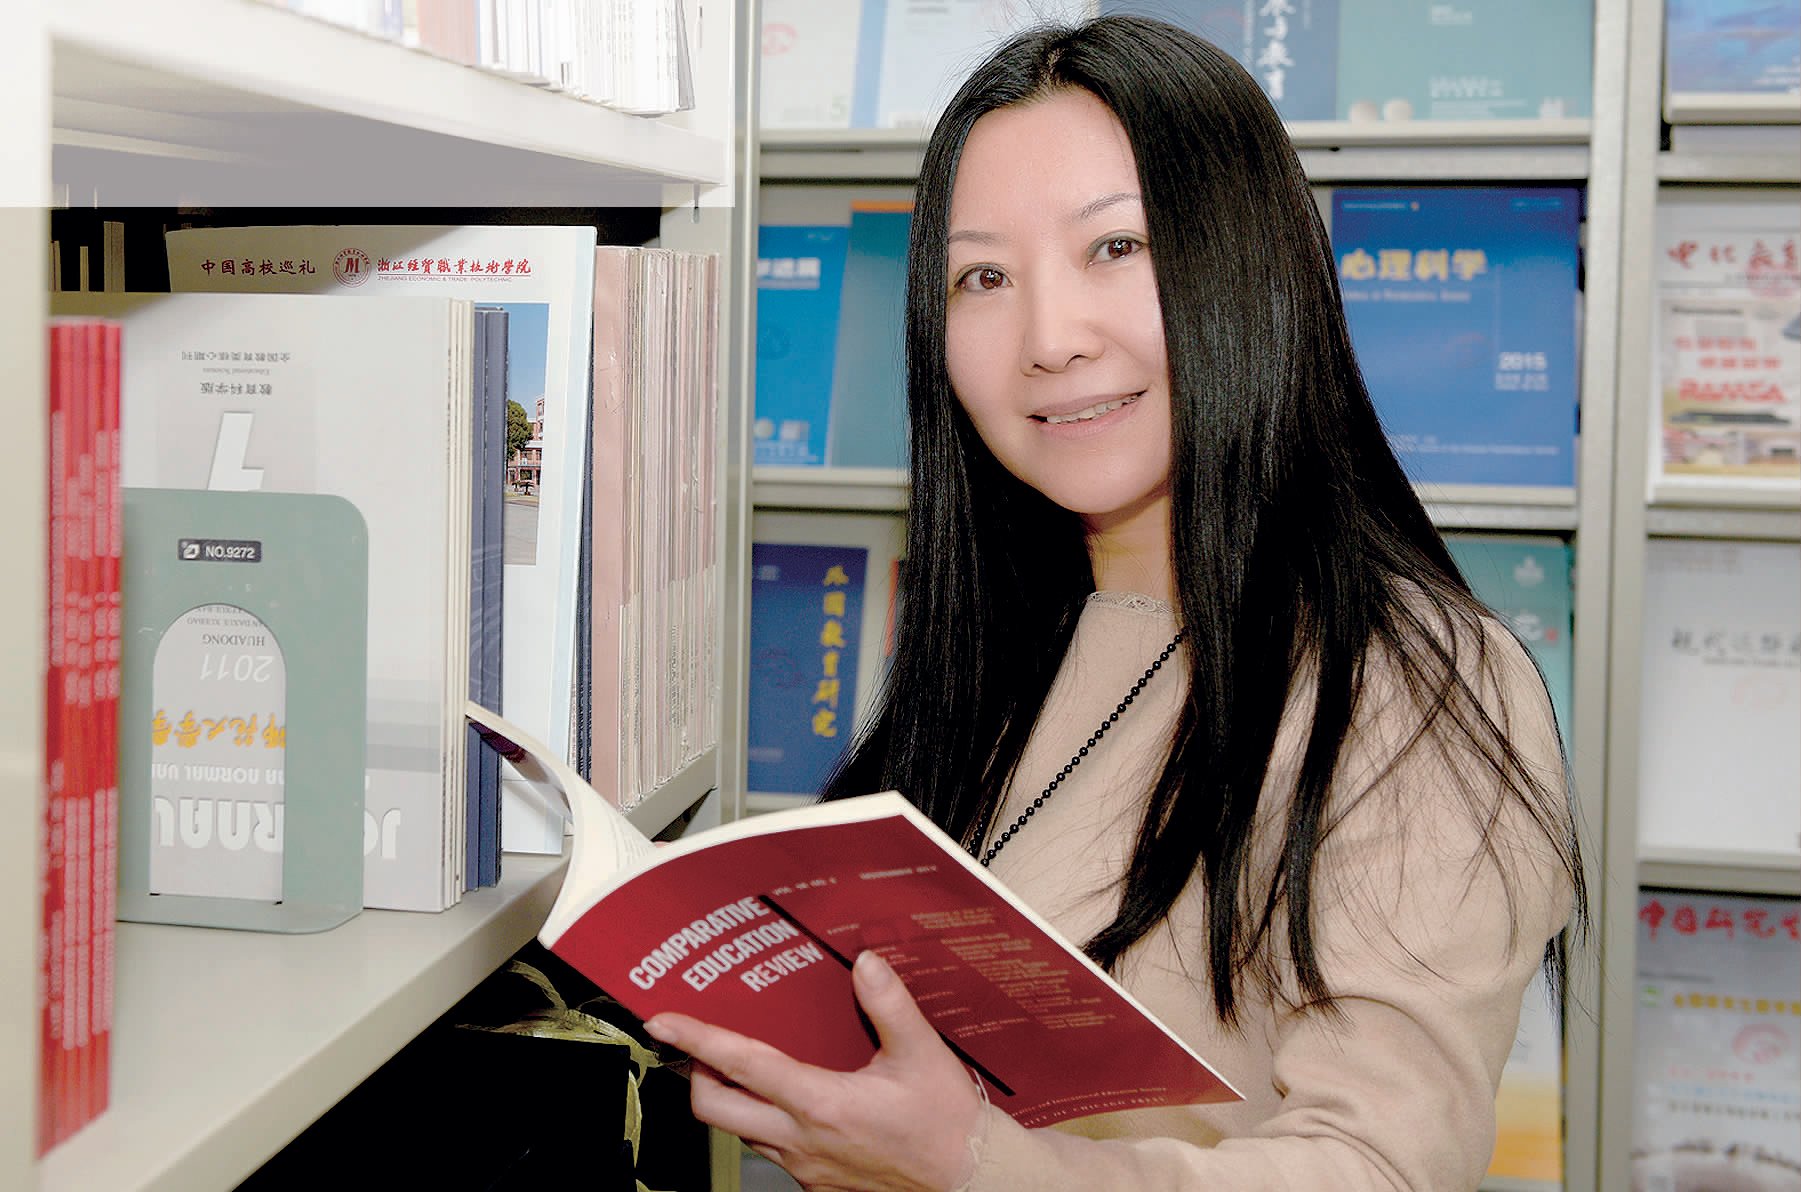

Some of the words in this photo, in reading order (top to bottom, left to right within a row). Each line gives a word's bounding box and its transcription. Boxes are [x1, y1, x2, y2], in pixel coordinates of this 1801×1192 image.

[201, 259, 316, 276] 中国高校巡礼
[1341, 248, 1488, 281] 心理科学
[200, 382, 272, 395] 教育科学版
[205, 545, 256, 559] NO.9272
[202, 633, 265, 647] HUADONG
[200, 652, 274, 683] 2011
[184, 764, 259, 785] NORMAL
[153, 796, 401, 861] JRNAL
[629, 896, 770, 990] COMPARATIVE
[681, 917, 799, 991] EDUCATION
[739, 942, 824, 992] REVIEW
